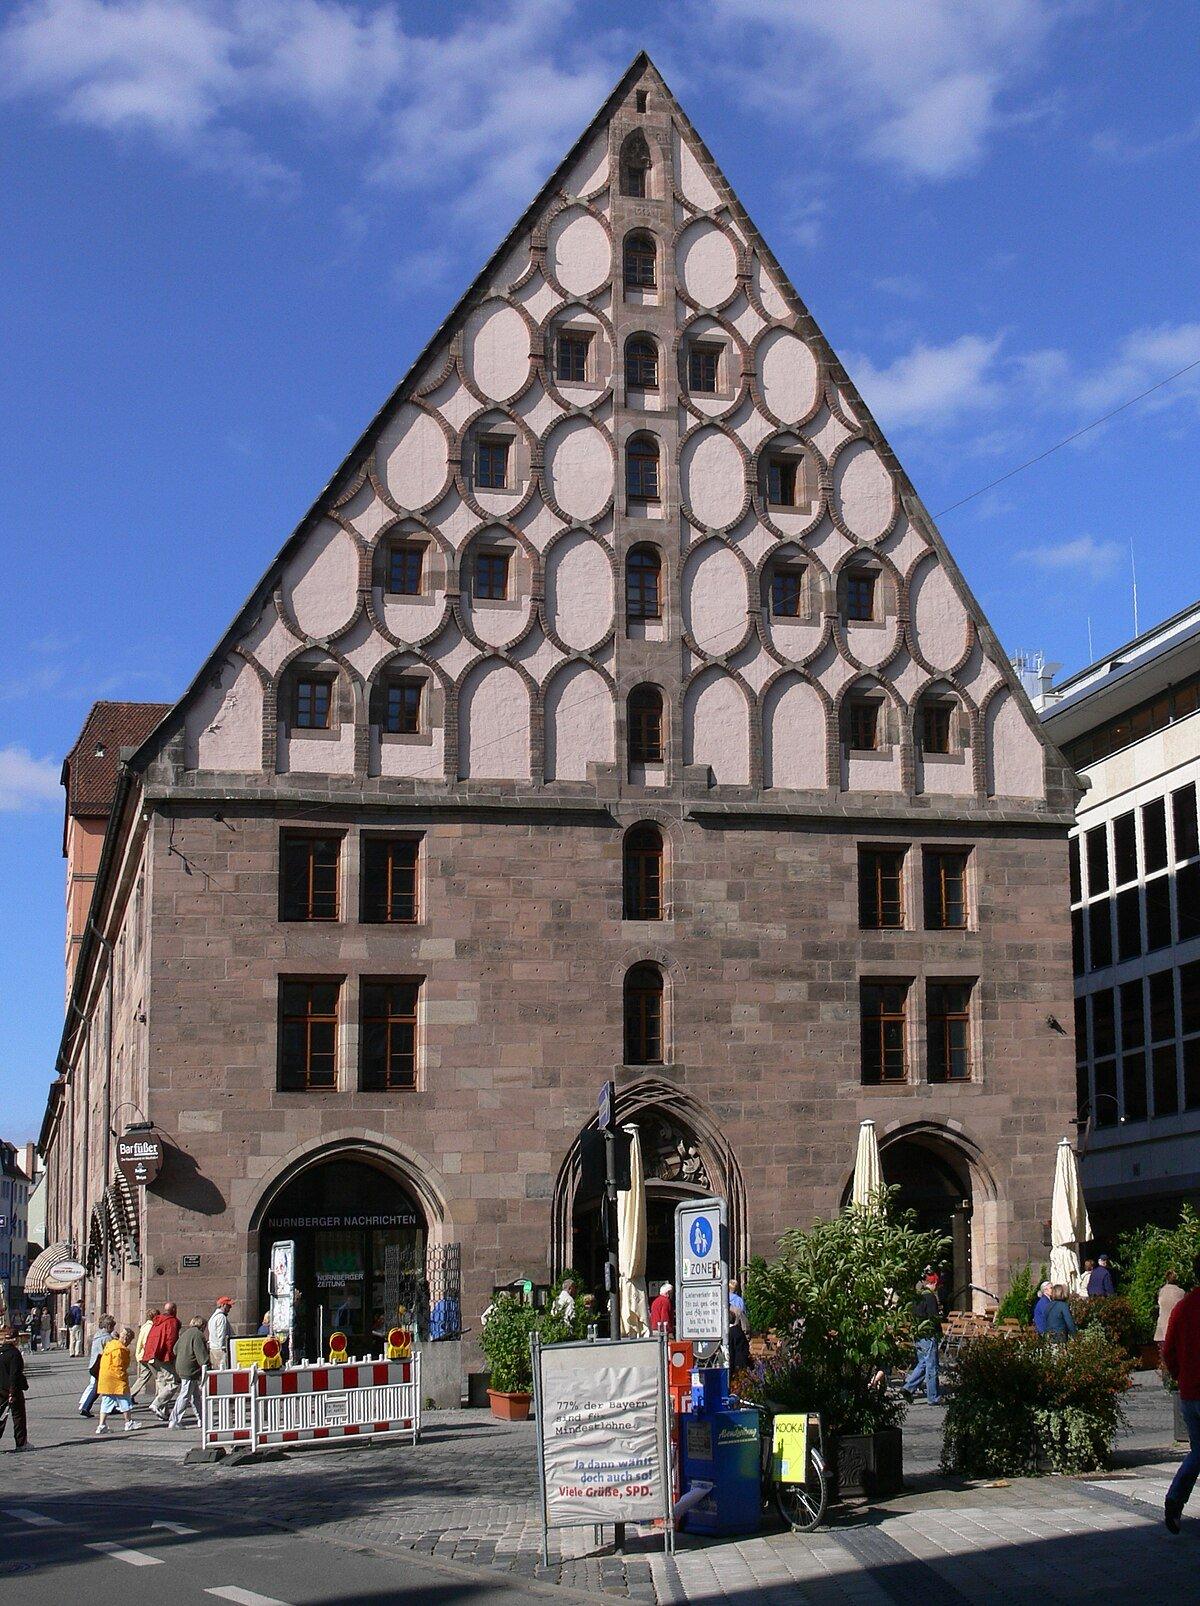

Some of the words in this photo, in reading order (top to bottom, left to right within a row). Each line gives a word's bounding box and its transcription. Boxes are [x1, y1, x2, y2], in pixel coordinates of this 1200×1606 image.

[120, 1142, 158, 1154] Barfüßer
[344, 1215, 416, 1225] NACHRICHTEN
[691, 1262, 712, 1275] ZONE
[317, 1280, 346, 1288] ZEITUNG
[557, 1402, 579, 1410] 77%
[584, 1402, 604, 1410] der
[609, 1401, 648, 1410] Bayern
[555, 1413, 581, 1422] sind
[574, 1460, 584, 1469] Ja
[588, 1460, 614, 1469] dann
[580, 1473, 604, 1483] doch
[607, 1471, 632, 1482] auch
[635, 1469, 653, 1480] so!
[559, 1486, 583, 1496] Viele
[586, 1486, 623, 1498] Grüße,
[626, 1486, 653, 1496] SPD.
